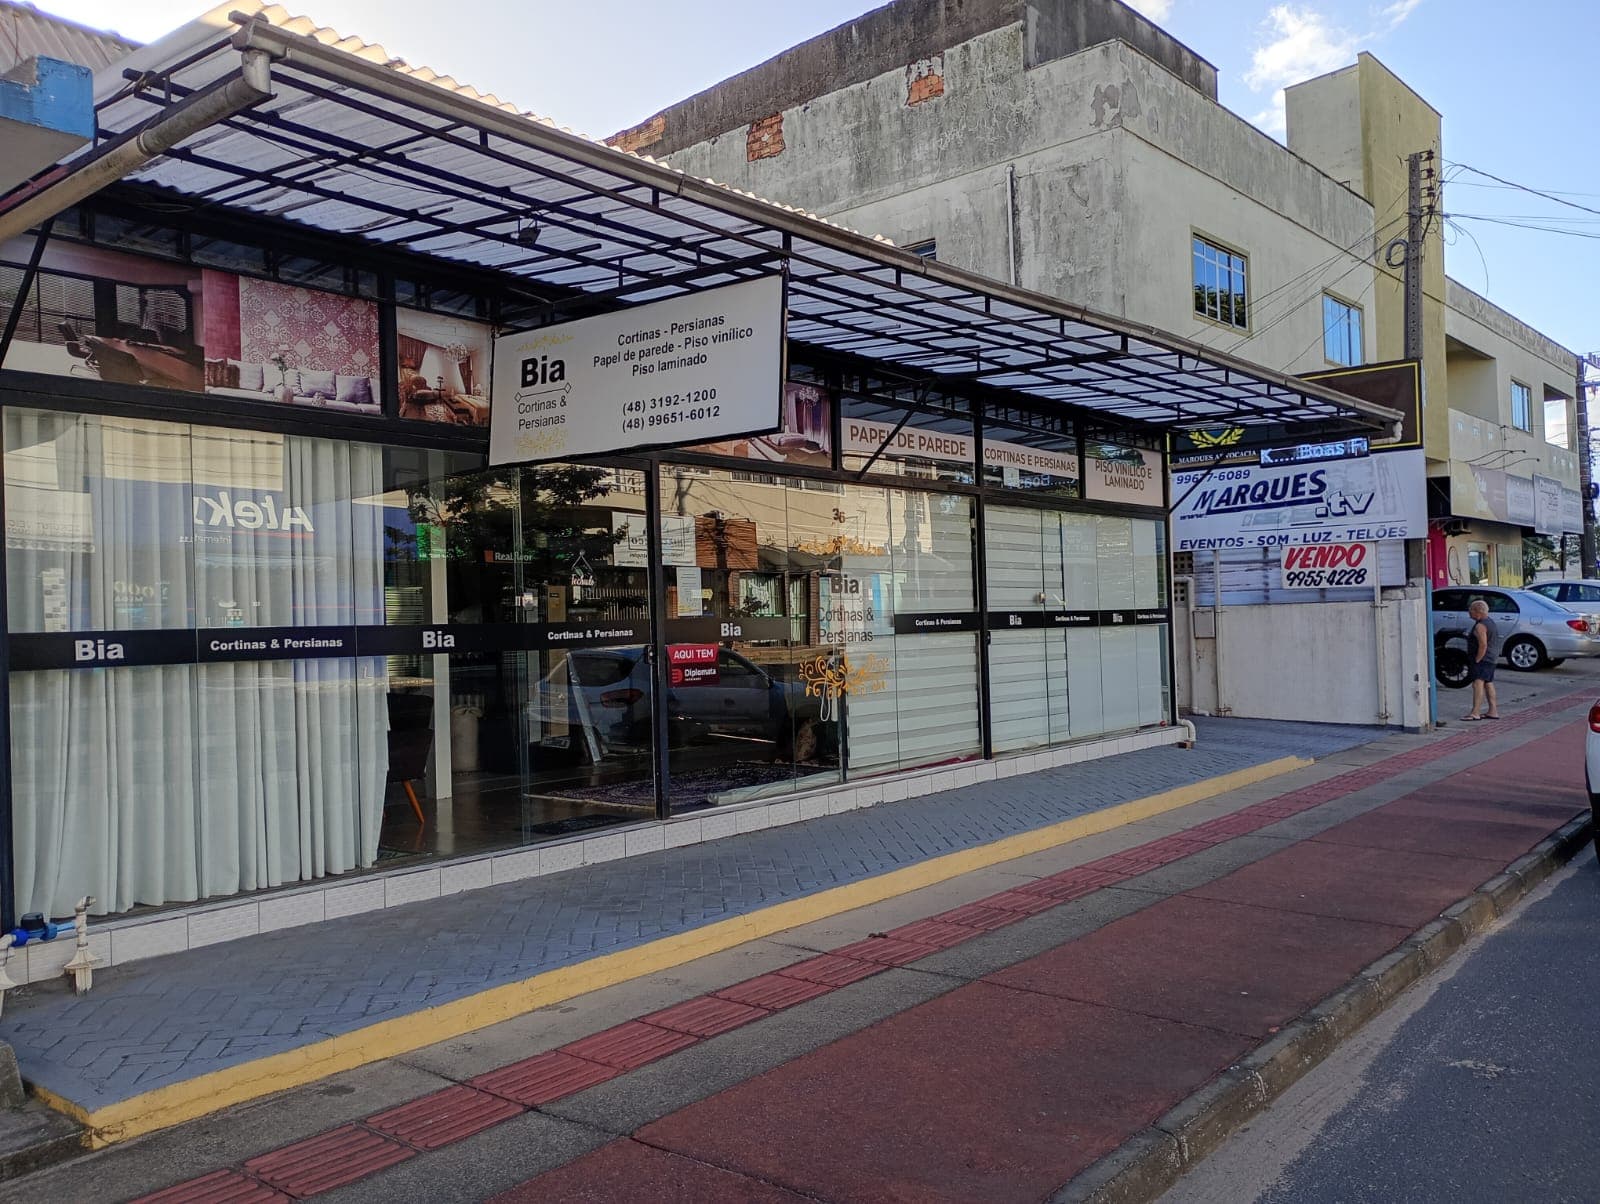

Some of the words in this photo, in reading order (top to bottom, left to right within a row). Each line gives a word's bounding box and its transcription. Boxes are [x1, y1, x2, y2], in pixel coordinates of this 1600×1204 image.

[618, 328, 661, 346] Cortinas
[671, 315, 725, 335] Persianas
[593, 351, 621, 368] Papel
[623, 350, 636, 362] de
[639, 342, 675, 361] parede
[684, 332, 709, 349] Piso
[711, 326, 753, 345] vinílico
[521, 355, 566, 388] Bia
[632, 361, 655, 377] Piso
[657, 352, 707, 372] laminado
[518, 398, 557, 415] Cortinas
[559, 395, 568, 407] &
[622, 401, 647, 415] (48)
[650, 388, 717, 410] 3192-1200
[518, 413, 566, 431] Persianas
[622, 417, 645, 433] (48)
[648, 405, 720, 427] 99651-6012
[850, 424, 894, 446] PAPEL
[897, 432, 915, 449] DE
[918, 435, 967, 457] PAREDE
[984, 447, 1026, 465] CORTINAS
[1028, 455, 1033, 465] E
[1034, 456, 1077, 473] PERSIANAS
[1179, 455, 1213, 464] MARQUES
[1095, 460, 1113, 473] PISO
[1147, 467, 1153, 479] E
[1104, 474, 1145, 491] LAMINADO
[1192, 469, 1327, 511] MARQUES
[1180, 536, 1244, 550] EVENTOS
[1257, 534, 1289, 546] SOM
[1302, 531, 1332, 544] LUZ
[1346, 525, 1408, 540] TELÕES
[1284, 544, 1367, 570] VENDO
[831, 575, 860, 594] Bia
[818, 606, 863, 622] Cortinas
[866, 607, 875, 621] &
[1009, 615, 1022, 626] Bia
[1112, 613, 1123, 623] Bia
[547, 630, 584, 641] Cortinas
[586, 629, 593, 639] &
[594, 628, 633, 639] Persianas
[720, 622, 742, 637] Bia
[818, 629, 874, 643] Persianas
[210, 638, 266, 652] Cortinas
[270, 638, 280, 649] &
[283, 636, 343, 649] Persianas
[422, 631, 455, 648] Bia
[74, 639, 125, 661] Bia
[673, 649, 694, 660] AQUI
[696, 648, 714, 658] TEM
[684, 667, 717, 677] Diplomata
